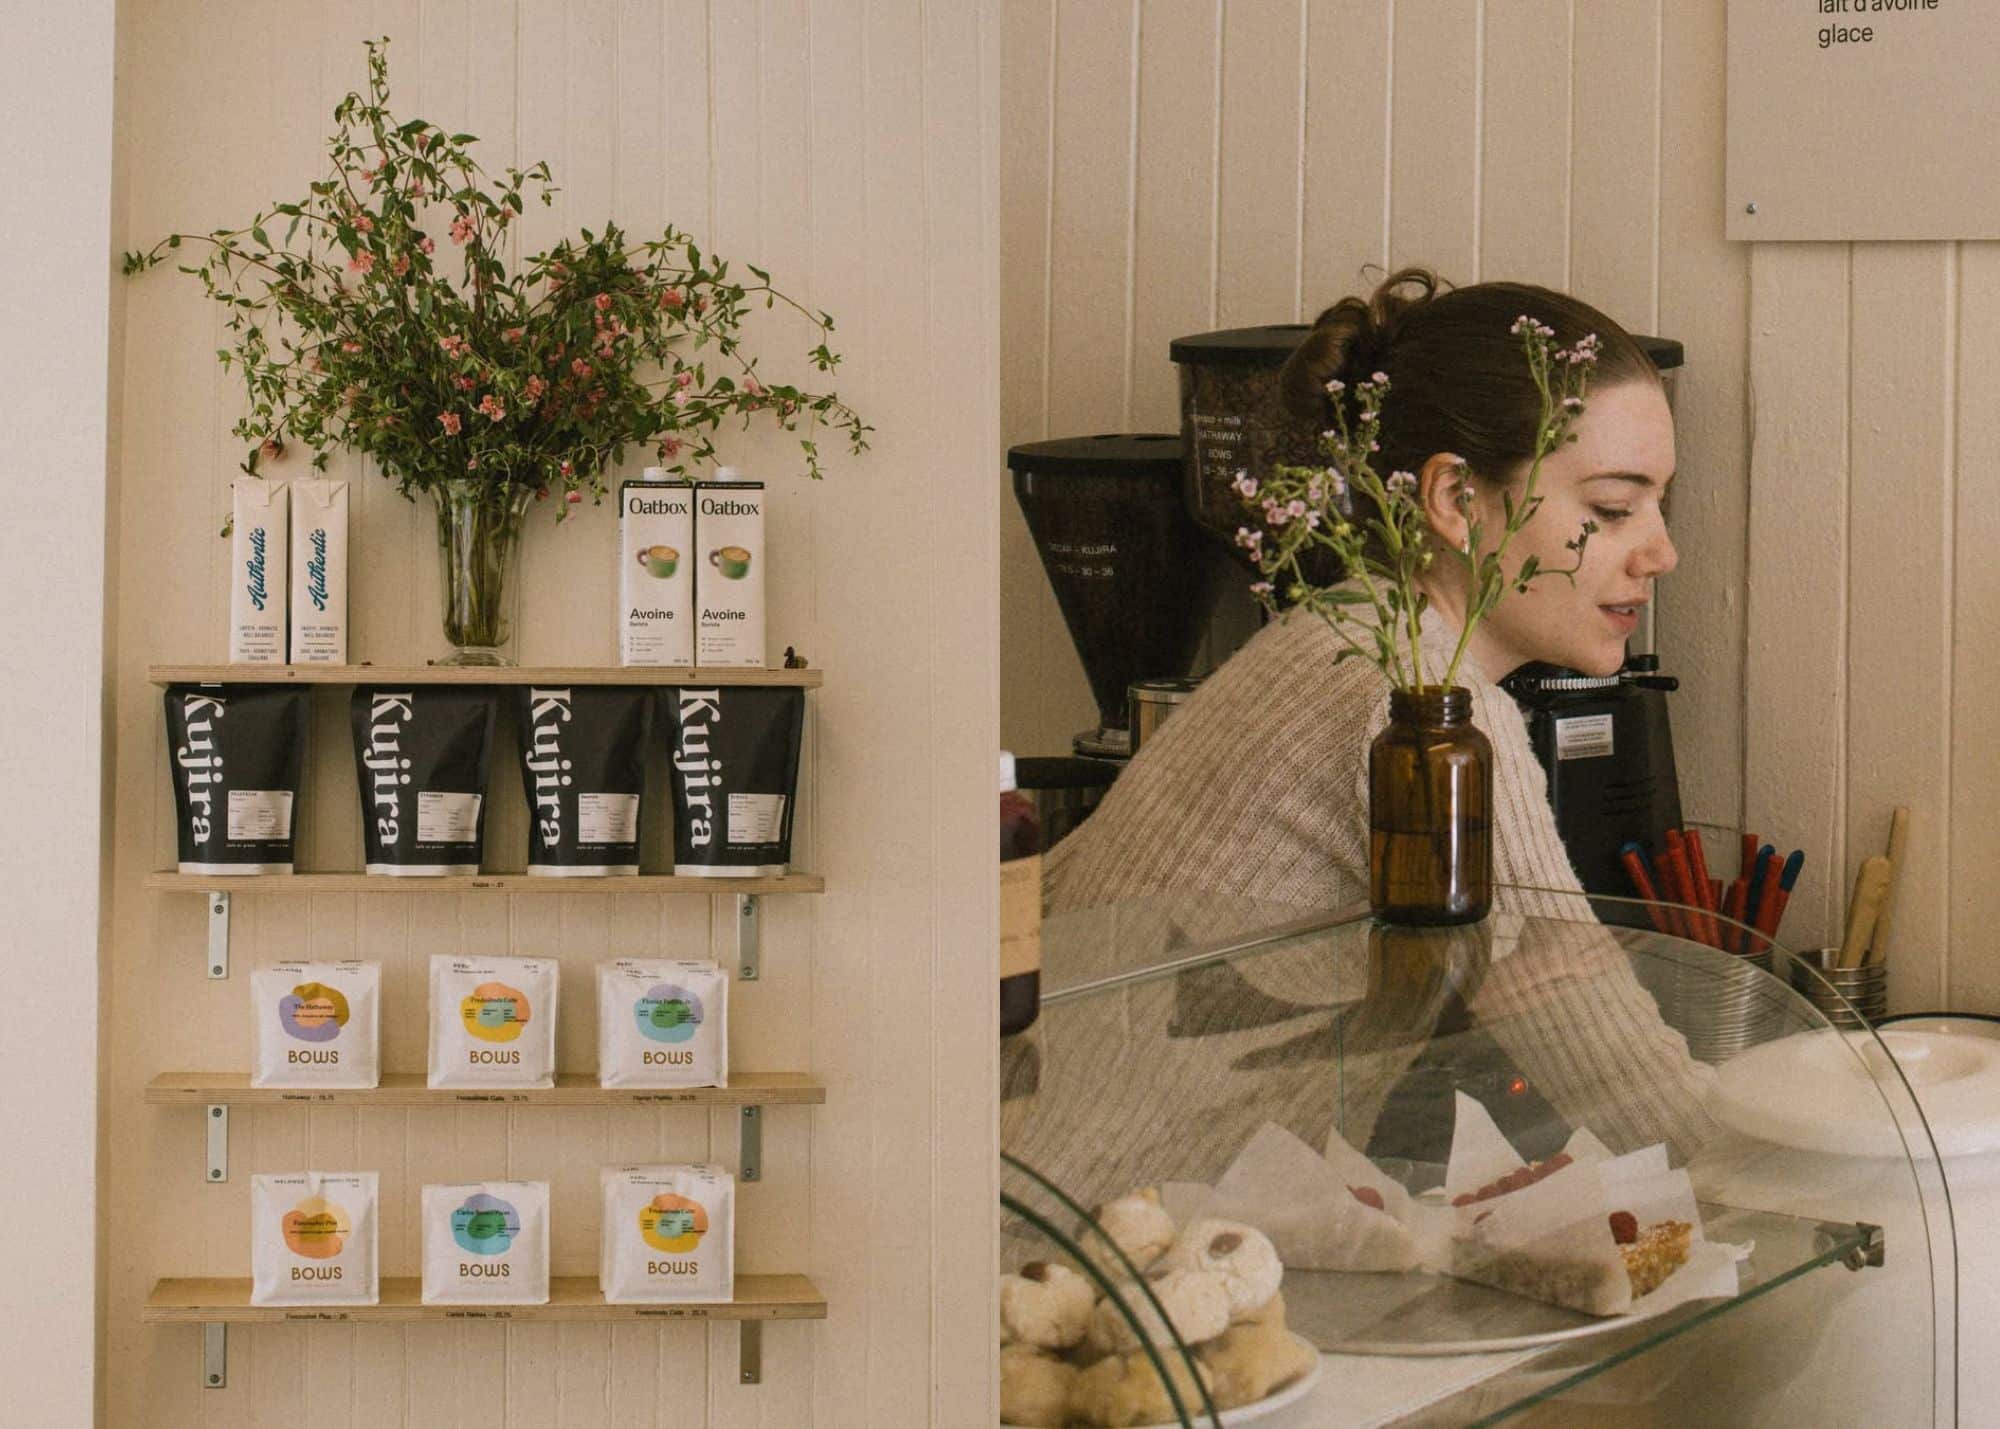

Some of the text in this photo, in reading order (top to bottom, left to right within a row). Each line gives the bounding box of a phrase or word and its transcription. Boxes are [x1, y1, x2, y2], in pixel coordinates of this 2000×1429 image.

[1818, 23, 1873, 48] glace
[629, 497, 688, 515] Oatbox
[701, 498, 759, 516] Oatbox
[246, 527, 268, 611] Authentic
[306, 528, 329, 612] Authentic
[629, 608, 674, 620] Avoine
[702, 609, 746, 620] Avoine
[177, 693, 226, 847] Kujira
[363, 692, 413, 848] Kujira
[526, 687, 572, 848] Kujira
[673, 688, 722, 849] Kujira
[288, 1050, 339, 1064] BOWS
[469, 1050, 521, 1064] BOWS
[643, 1051, 693, 1065] BOWS
[291, 1266, 343, 1281] BOWS
[459, 1263, 510, 1277] BOWS
[647, 1261, 698, 1275] BOWS
